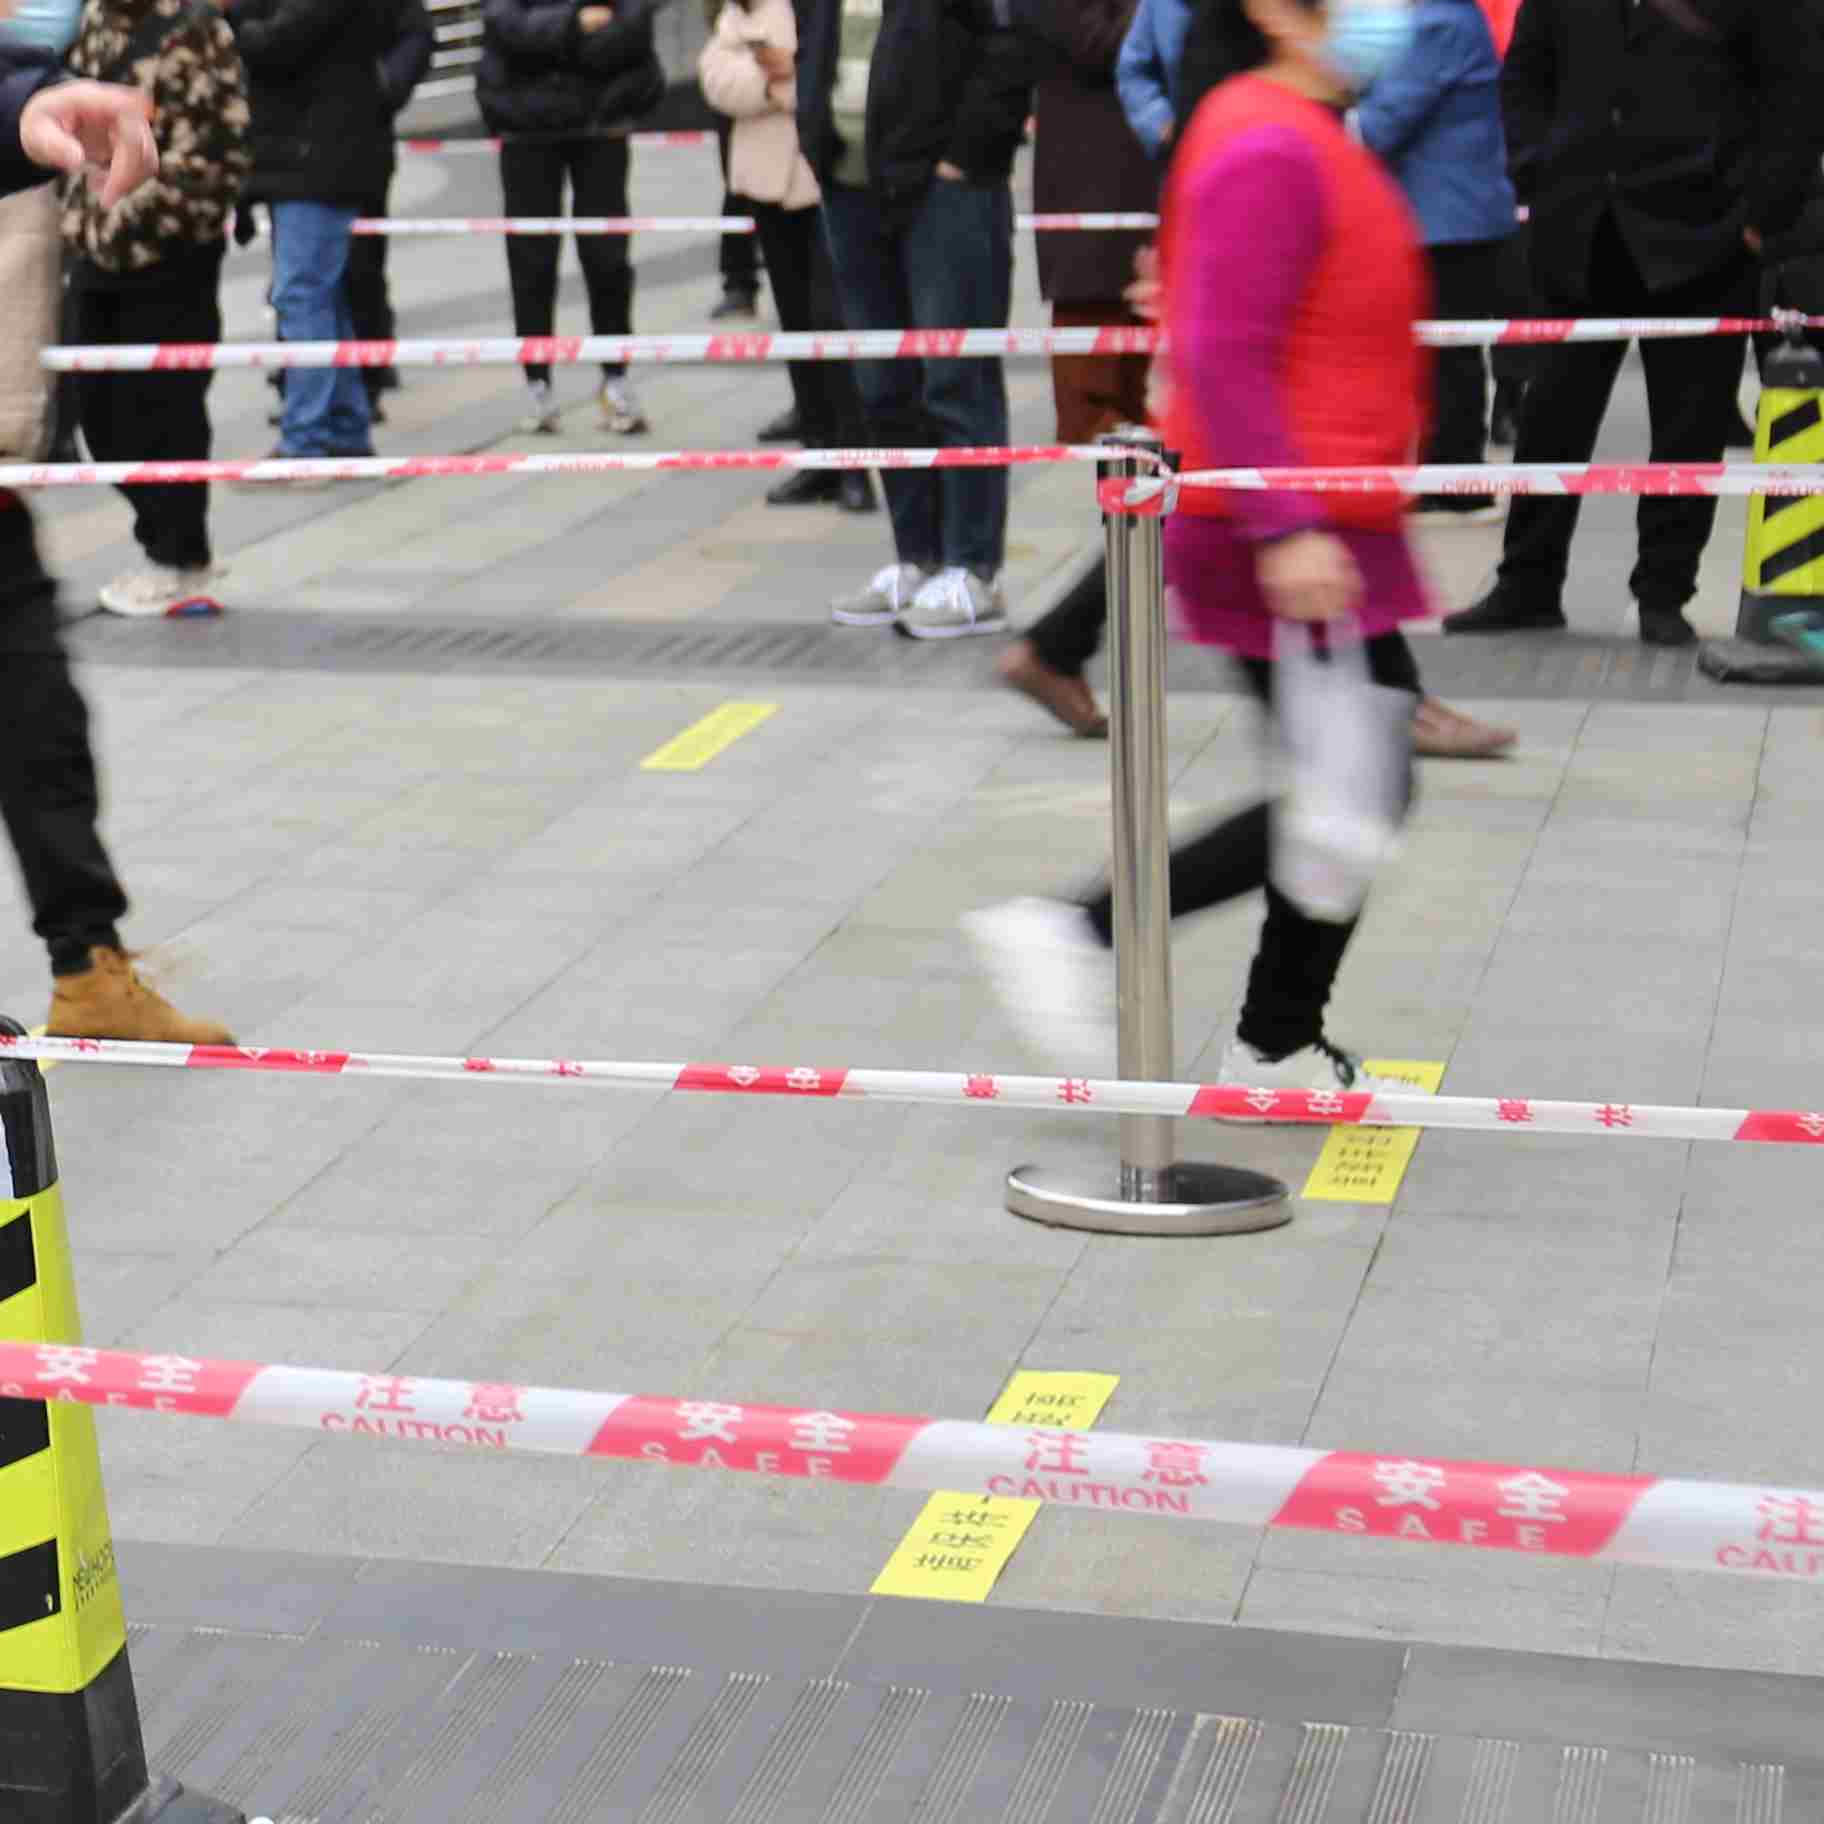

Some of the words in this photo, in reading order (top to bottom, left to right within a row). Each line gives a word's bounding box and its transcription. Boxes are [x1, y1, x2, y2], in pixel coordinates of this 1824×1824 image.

[34, 1343, 203, 1393] 安全
[355, 1374, 523, 1424] 注意
[675, 1399, 856, 1454] 安全
[1023, 1430, 1209, 1487] 注意
[1373, 1459, 1570, 1524] 安全
[1754, 1496, 1824, 1546] 注
[986, 1474, 1190, 1513] CAUTION
[1335, 1506, 1546, 1549] SAFE
